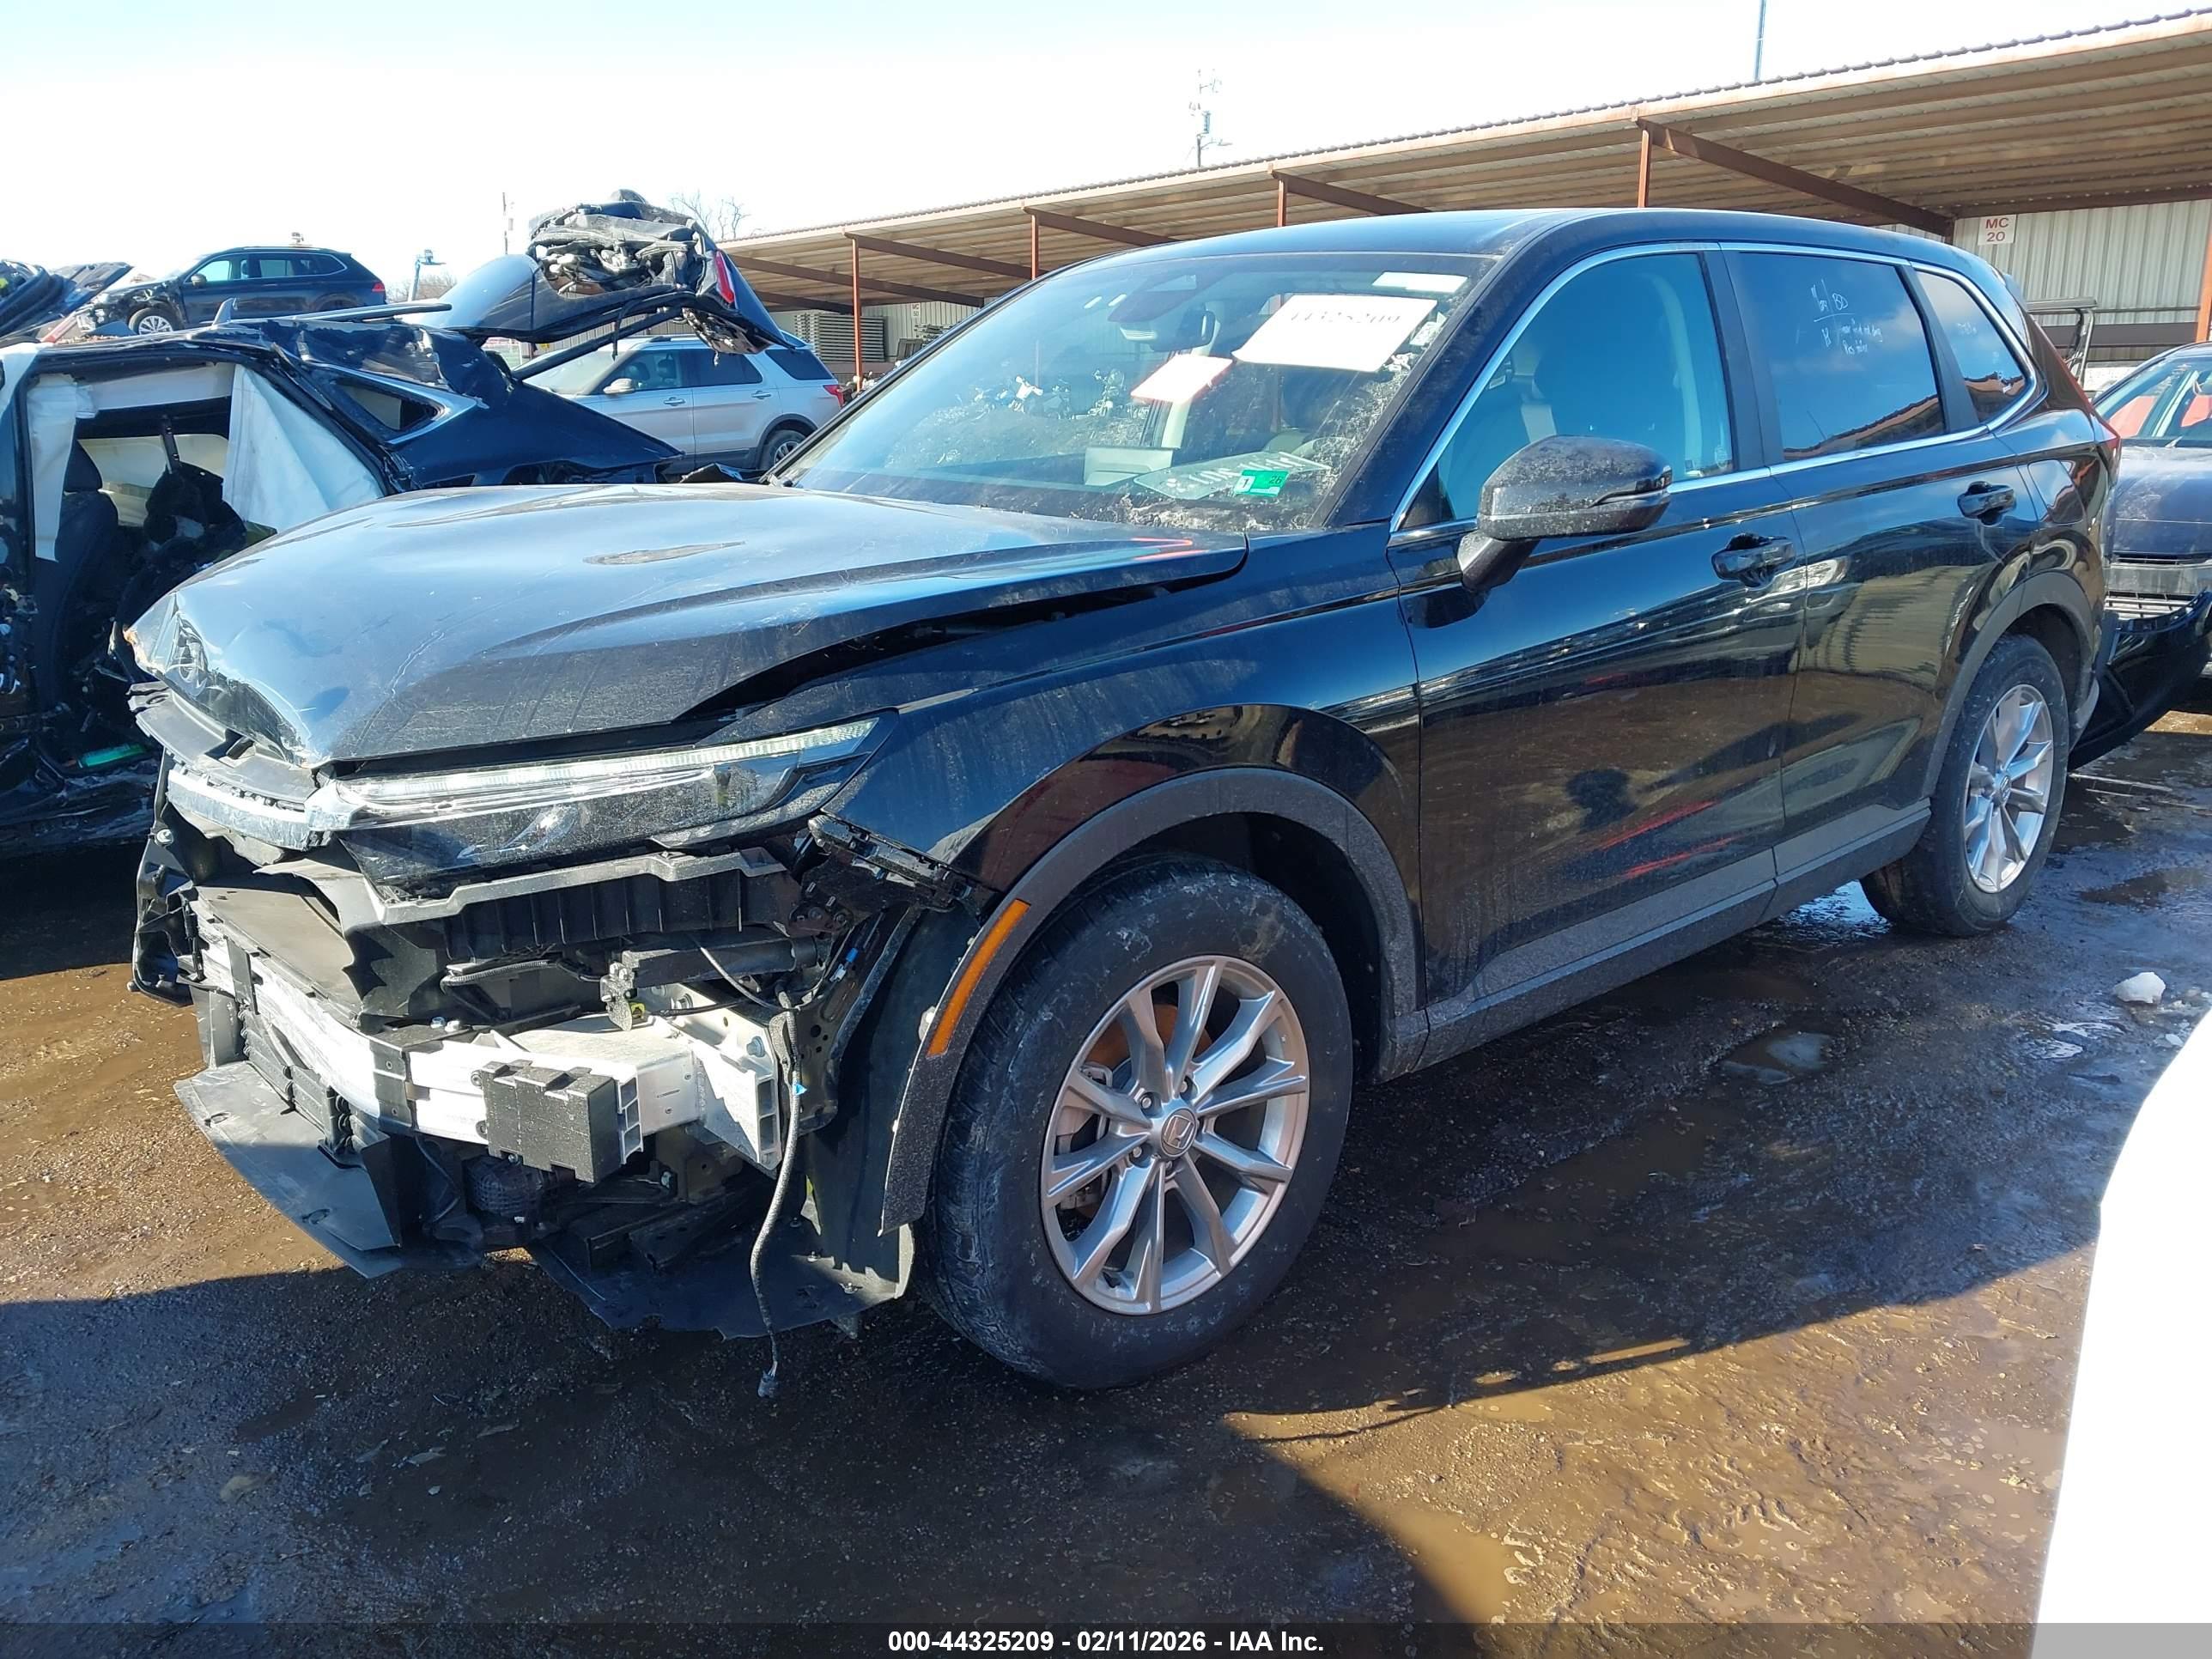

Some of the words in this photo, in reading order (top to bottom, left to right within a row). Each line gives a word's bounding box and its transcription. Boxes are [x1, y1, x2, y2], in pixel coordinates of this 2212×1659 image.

[1985, 217, 2009, 228] MC
[1986, 231, 2006, 242] 20
[1269, 475, 1282, 484] 26
